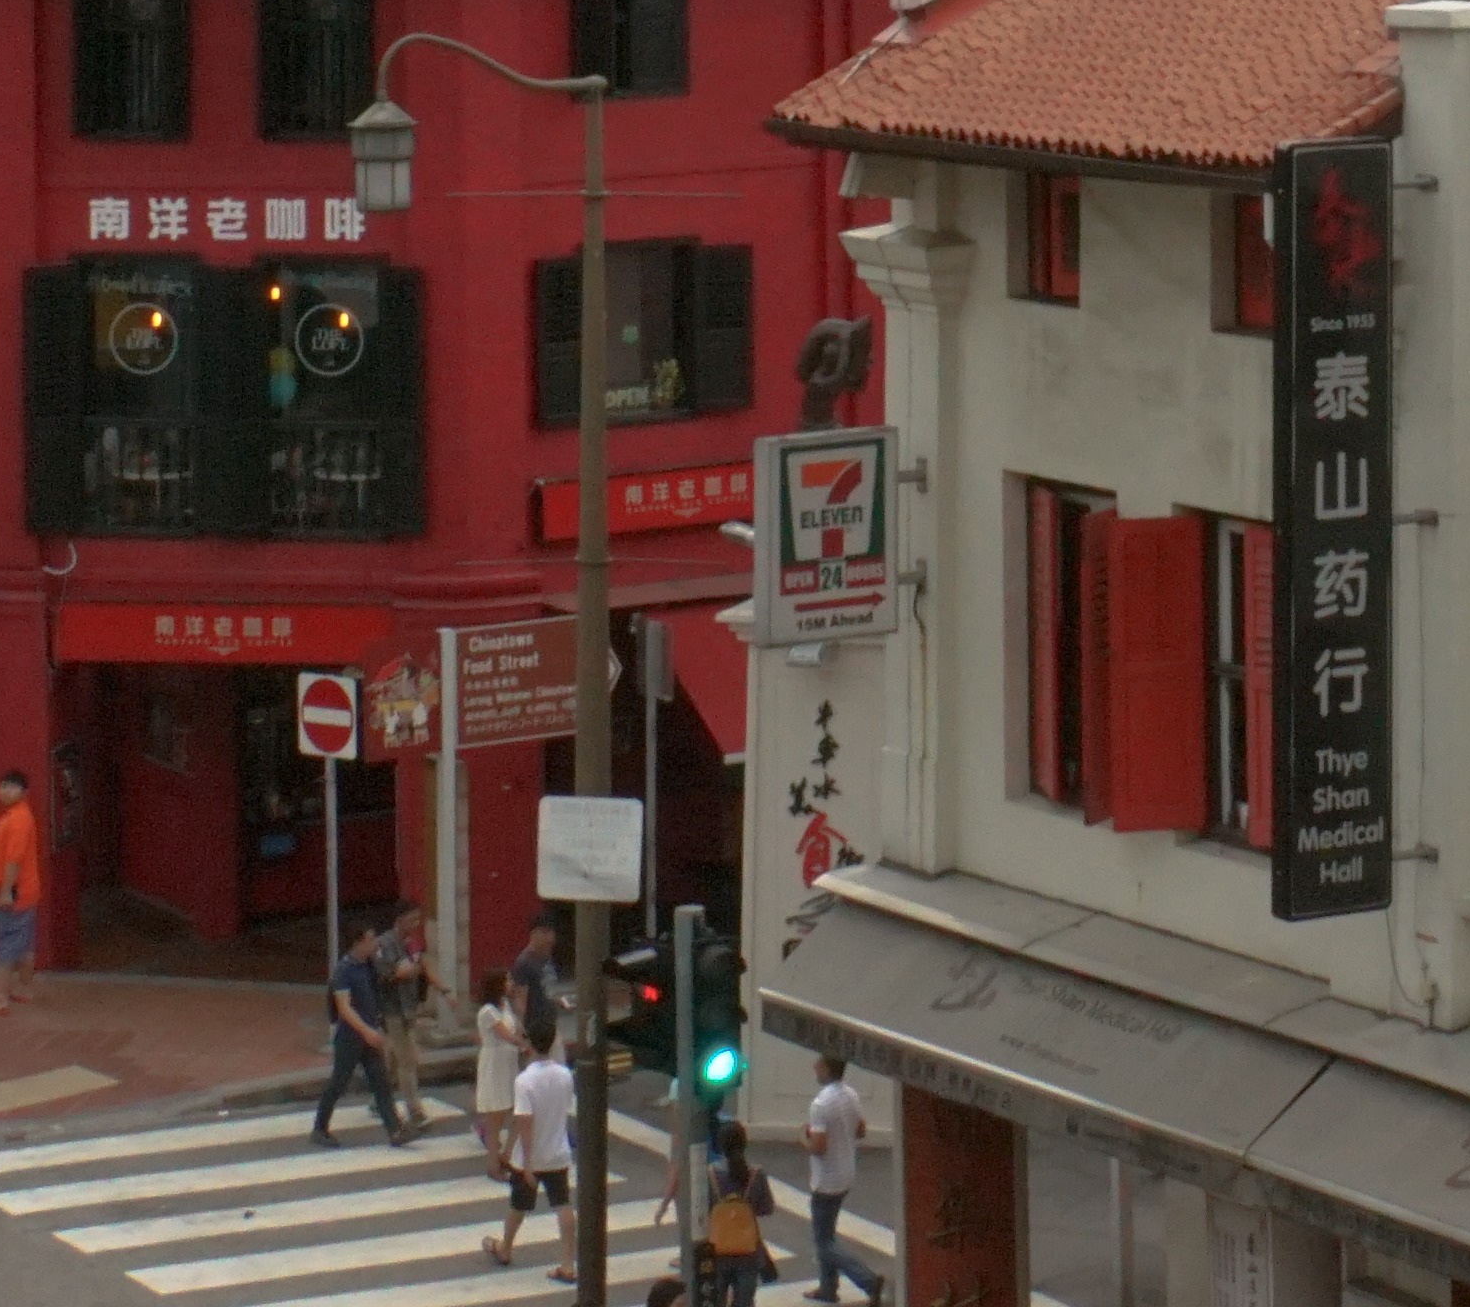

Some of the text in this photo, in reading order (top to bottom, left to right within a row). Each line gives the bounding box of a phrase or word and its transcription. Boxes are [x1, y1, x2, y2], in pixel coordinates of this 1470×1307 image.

[87, 196, 367, 244] 南洋老咖啡
[1313, 350, 1370, 717] 泰山药行
[821, 566, 843, 592] 24
[829, 611, 874, 629] Ahead
[468, 633, 535, 653] Chinatown
[463, 651, 540, 676] Food Street
[1315, 745, 1371, 779] Thye
[1312, 784, 1371, 814] Shan
[1297, 819, 1385, 852] Medical
[1319, 857, 1364, 887] Hall
